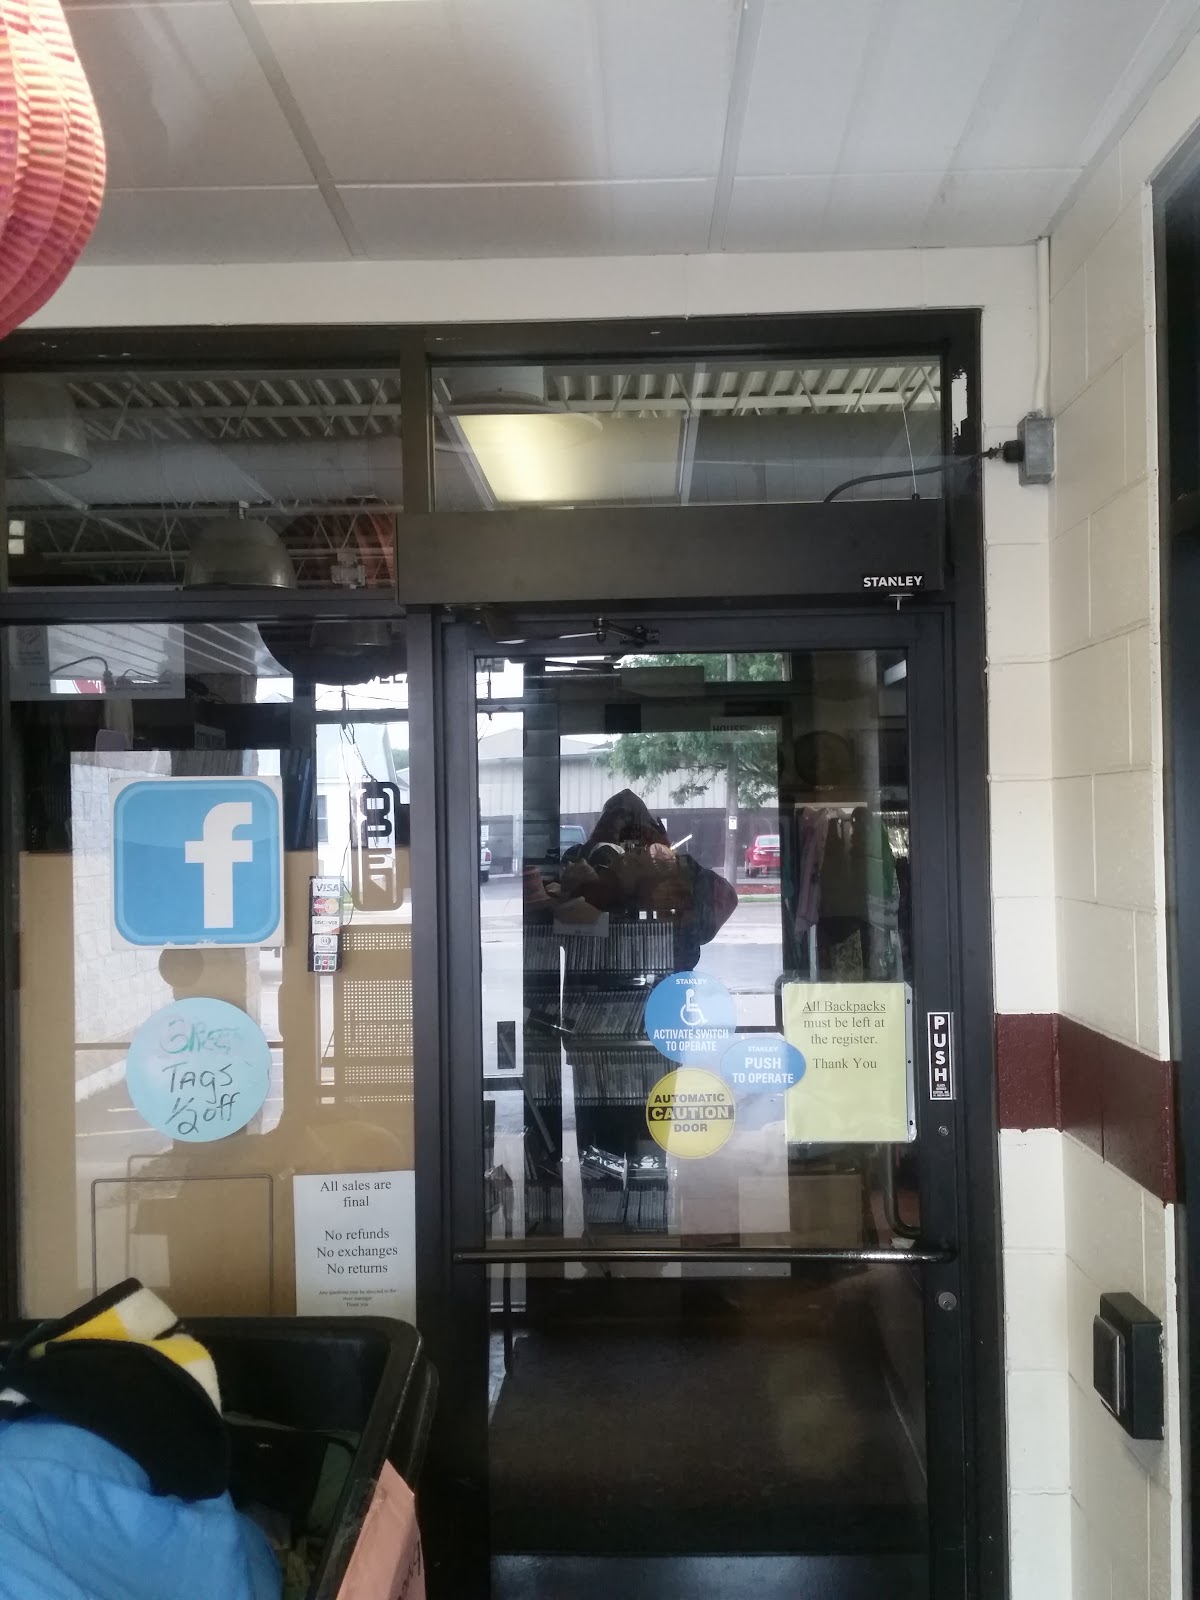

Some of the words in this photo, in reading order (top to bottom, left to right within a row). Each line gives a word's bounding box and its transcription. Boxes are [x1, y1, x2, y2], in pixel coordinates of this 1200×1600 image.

[863, 576, 922, 587] STANLEY
[185, 802, 253, 928] f
[316, 883, 339, 892] VISA
[802, 1001, 820, 1012] All
[824, 1000, 886, 1013] Backpacks
[803, 1019, 831, 1028] must
[835, 1017, 848, 1028] be
[852, 1017, 870, 1028] left
[874, 1019, 885, 1028] at
[653, 1028, 694, 1040] ACTIVATE
[695, 1028, 729, 1040] SWITCH
[810, 1034, 828, 1044] the
[832, 1033, 878, 1047] register.
[665, 1041, 677, 1051] TO
[679, 1040, 717, 1051] OPERATE
[933, 1015, 948, 1082] PUSH
[744, 1057, 782, 1069] PUSH
[812, 1058, 848, 1068] Thank
[853, 1058, 877, 1068] You
[732, 1072, 745, 1084] TO
[748, 1072, 794, 1084] OPERATE
[654, 1093, 725, 1103] AUTOMATIC
[203, 1092, 241, 1122] off
[651, 1106, 729, 1120] CAUTION
[674, 1124, 708, 1132] DOOR
[320, 1181, 338, 1192] All
[342, 1180, 371, 1191] sales
[374, 1181, 392, 1190] are
[343, 1196, 369, 1208] final
[325, 1230, 342, 1241] No
[346, 1228, 390, 1240] refunds
[317, 1247, 334, 1258] No
[337, 1246, 398, 1259] exchanges
[327, 1263, 344, 1274] No
[348, 1264, 388, 1274] returns
